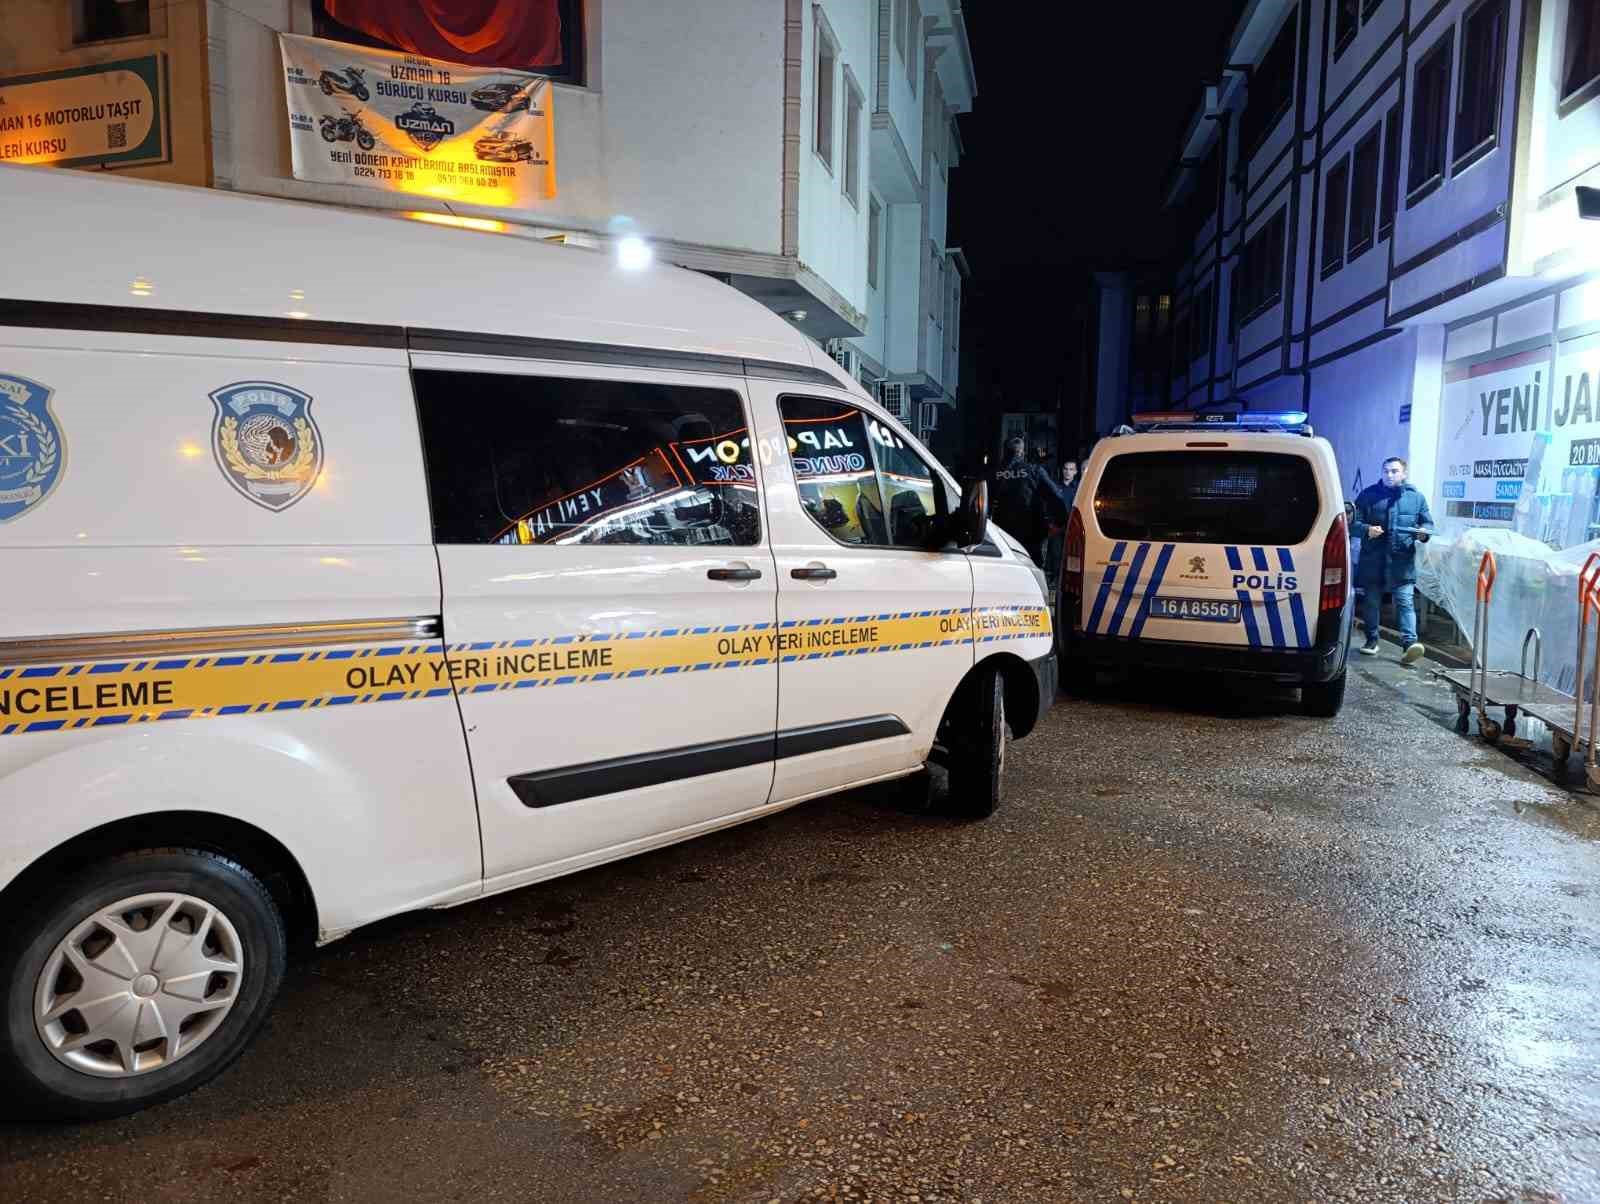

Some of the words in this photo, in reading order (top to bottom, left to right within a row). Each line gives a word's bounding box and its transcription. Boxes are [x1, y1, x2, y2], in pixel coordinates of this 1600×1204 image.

[391, 65, 433, 82] UZMAN
[376, 80, 424, 100] SÜRÜCÜ
[428, 87, 467, 104] KURSU
[28, 113, 42, 128] 16
[45, 104, 104, 127] MOTORLU
[107, 99, 142, 120] TAŞIT
[400, 119, 451, 134] UZMAN
[26, 138, 67, 156] KURSU
[330, 150, 351, 163] YENİ
[355, 152, 389, 168] DÖNEM
[354, 167, 375, 178] 0224
[1480, 370, 1541, 436] YENİ
[1571, 445, 1586, 465] 20
[1161, 600, 1177, 613] 16
[1180, 602, 1188, 614] A
[1191, 602, 1238, 617] 85561
[940, 616, 970, 633] OLAY
[717, 636, 762, 655] OLAY
[346, 662, 421, 690] OLAY
